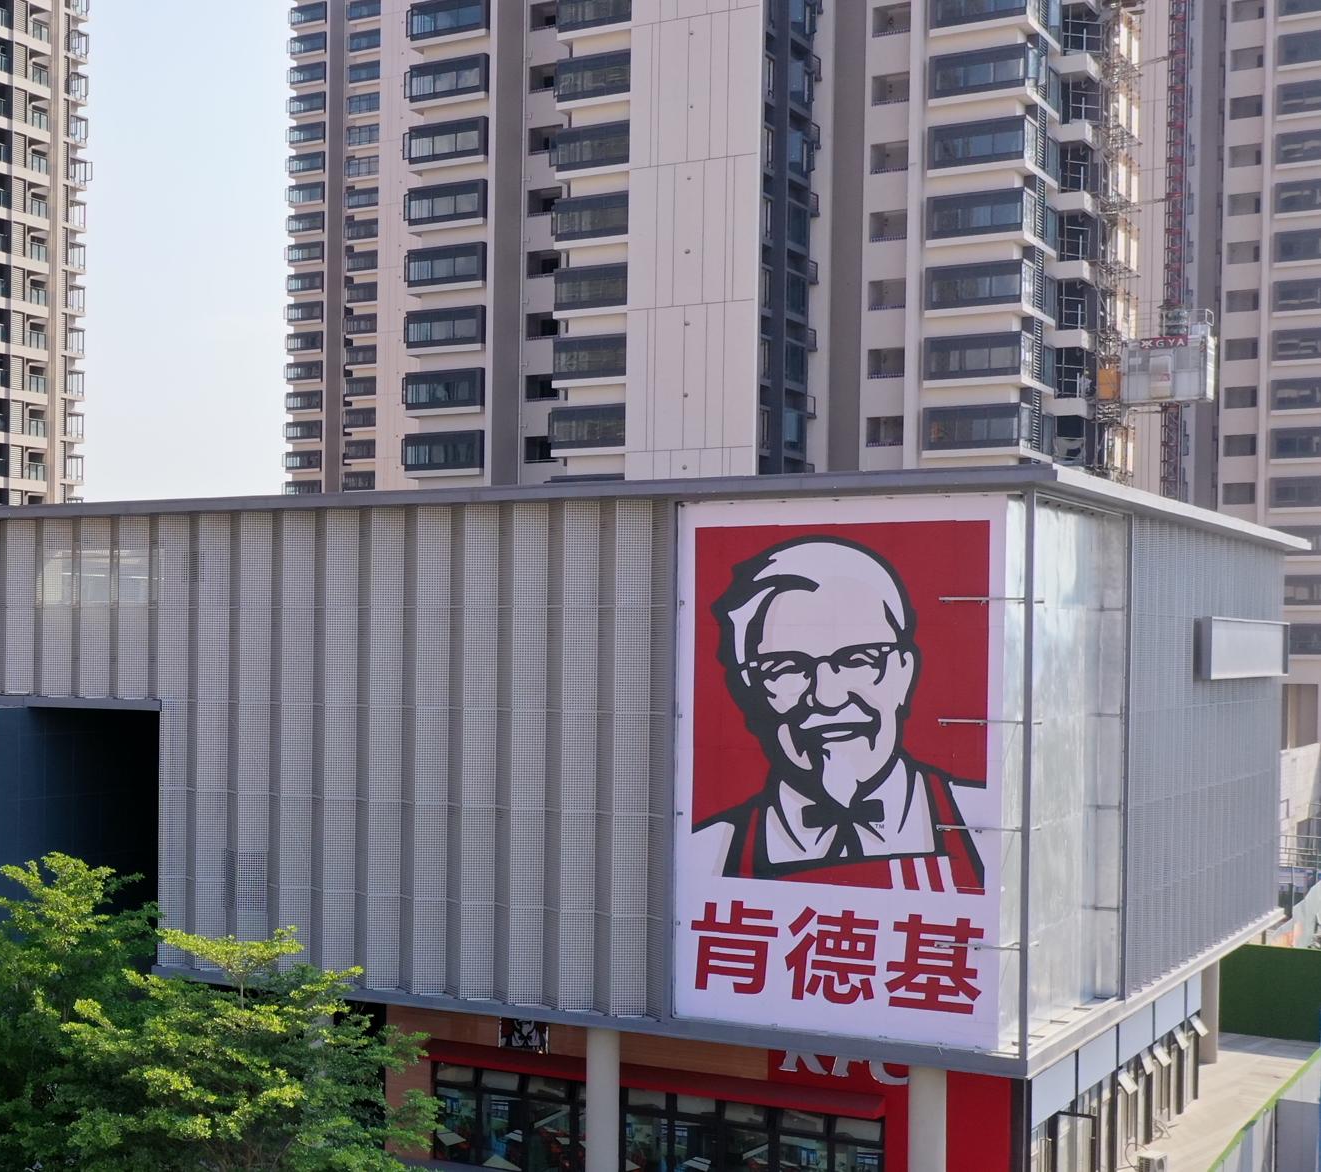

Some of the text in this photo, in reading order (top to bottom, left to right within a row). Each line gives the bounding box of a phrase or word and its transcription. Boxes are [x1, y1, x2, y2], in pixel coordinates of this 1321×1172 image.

[1155, 338, 1185, 348] GYA
[690, 900, 985, 1015] 肯德基
